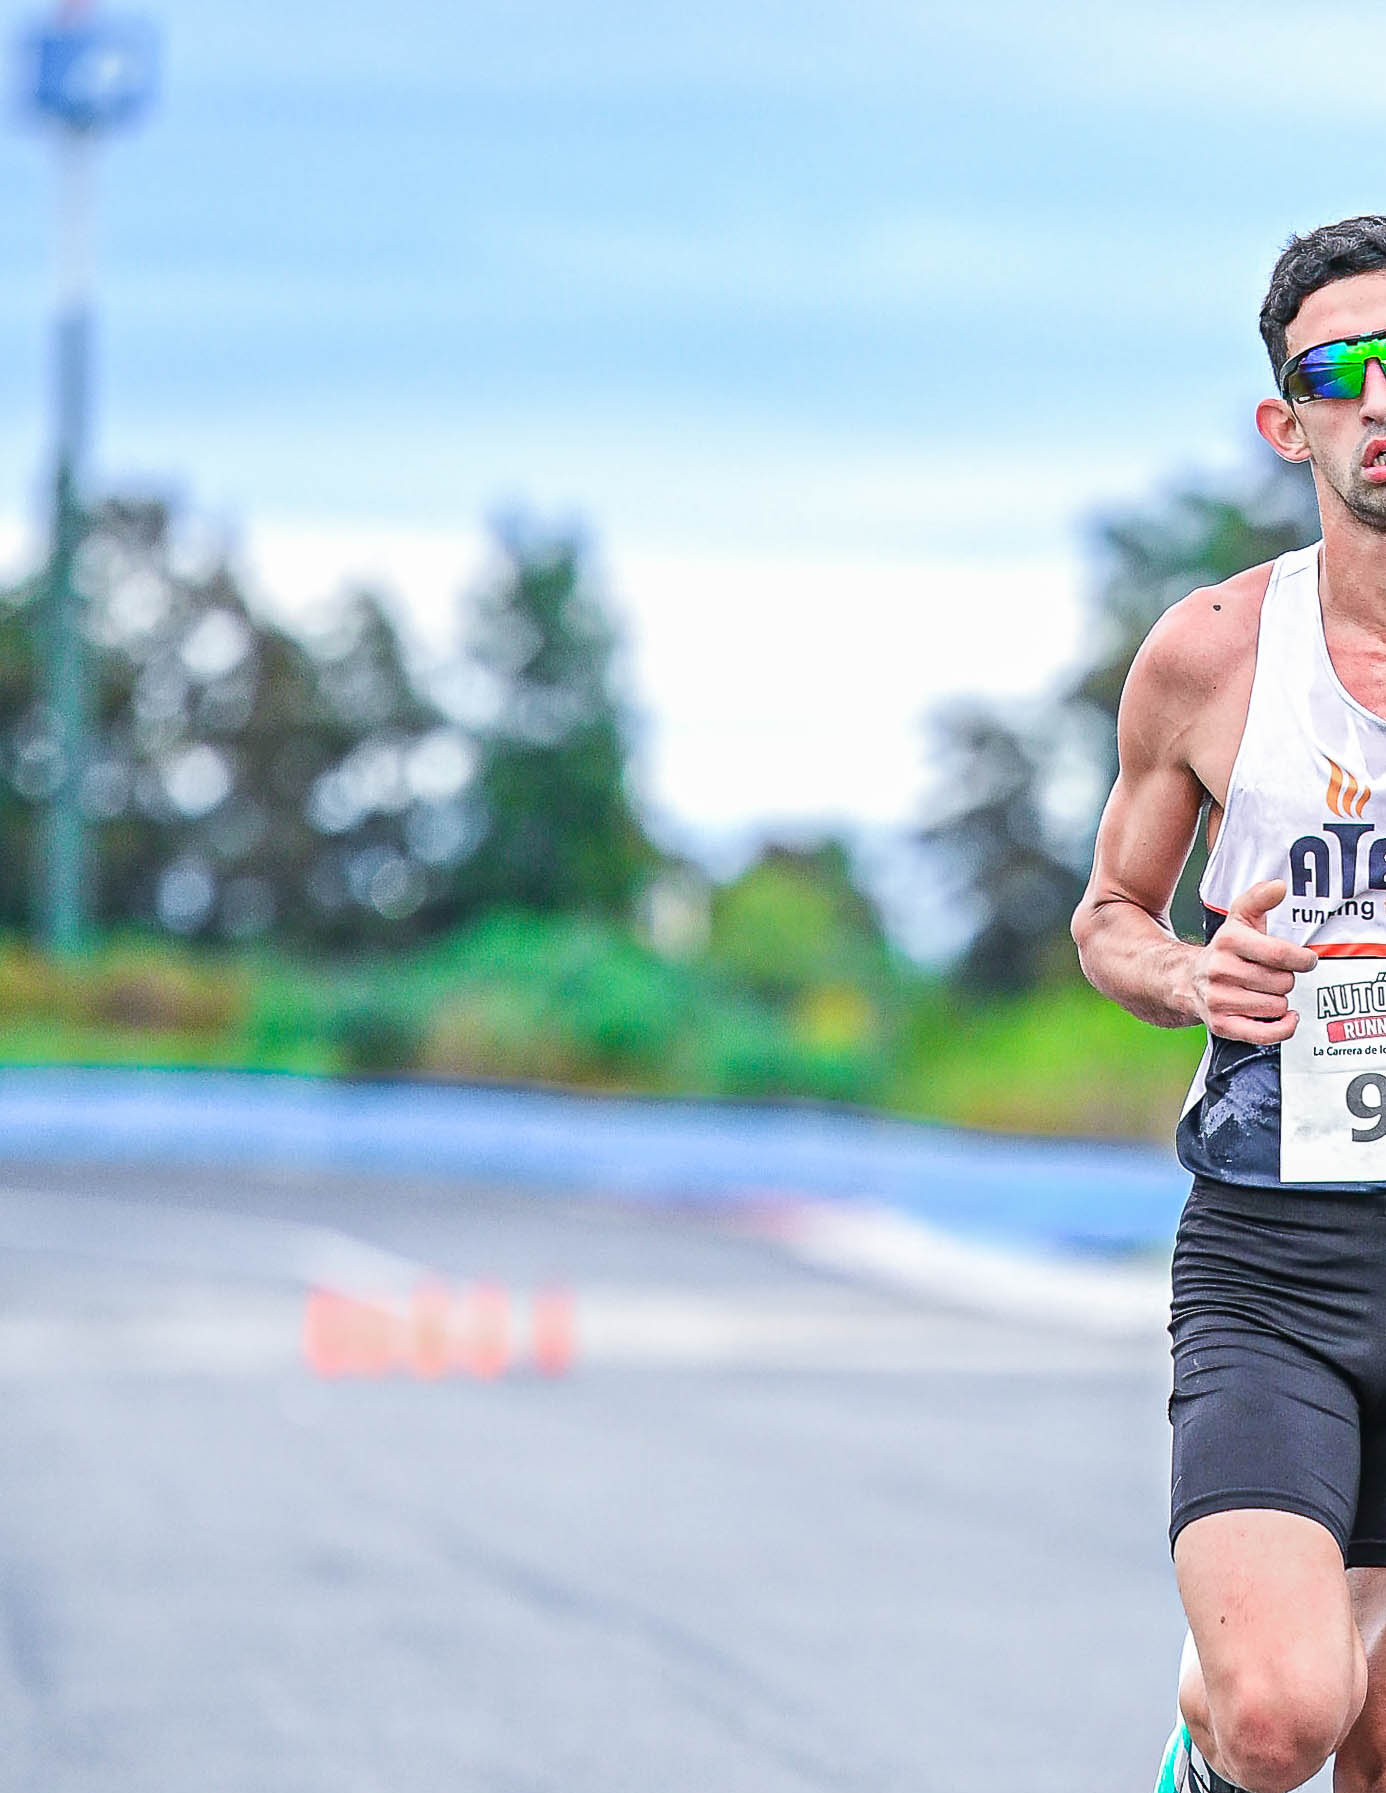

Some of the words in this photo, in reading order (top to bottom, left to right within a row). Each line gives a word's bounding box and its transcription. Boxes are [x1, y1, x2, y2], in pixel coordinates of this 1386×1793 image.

[1313, 1046, 1324, 1056] La
[1326, 1046, 1362, 1056] Carrera
[1364, 1045, 1378, 1055] de
